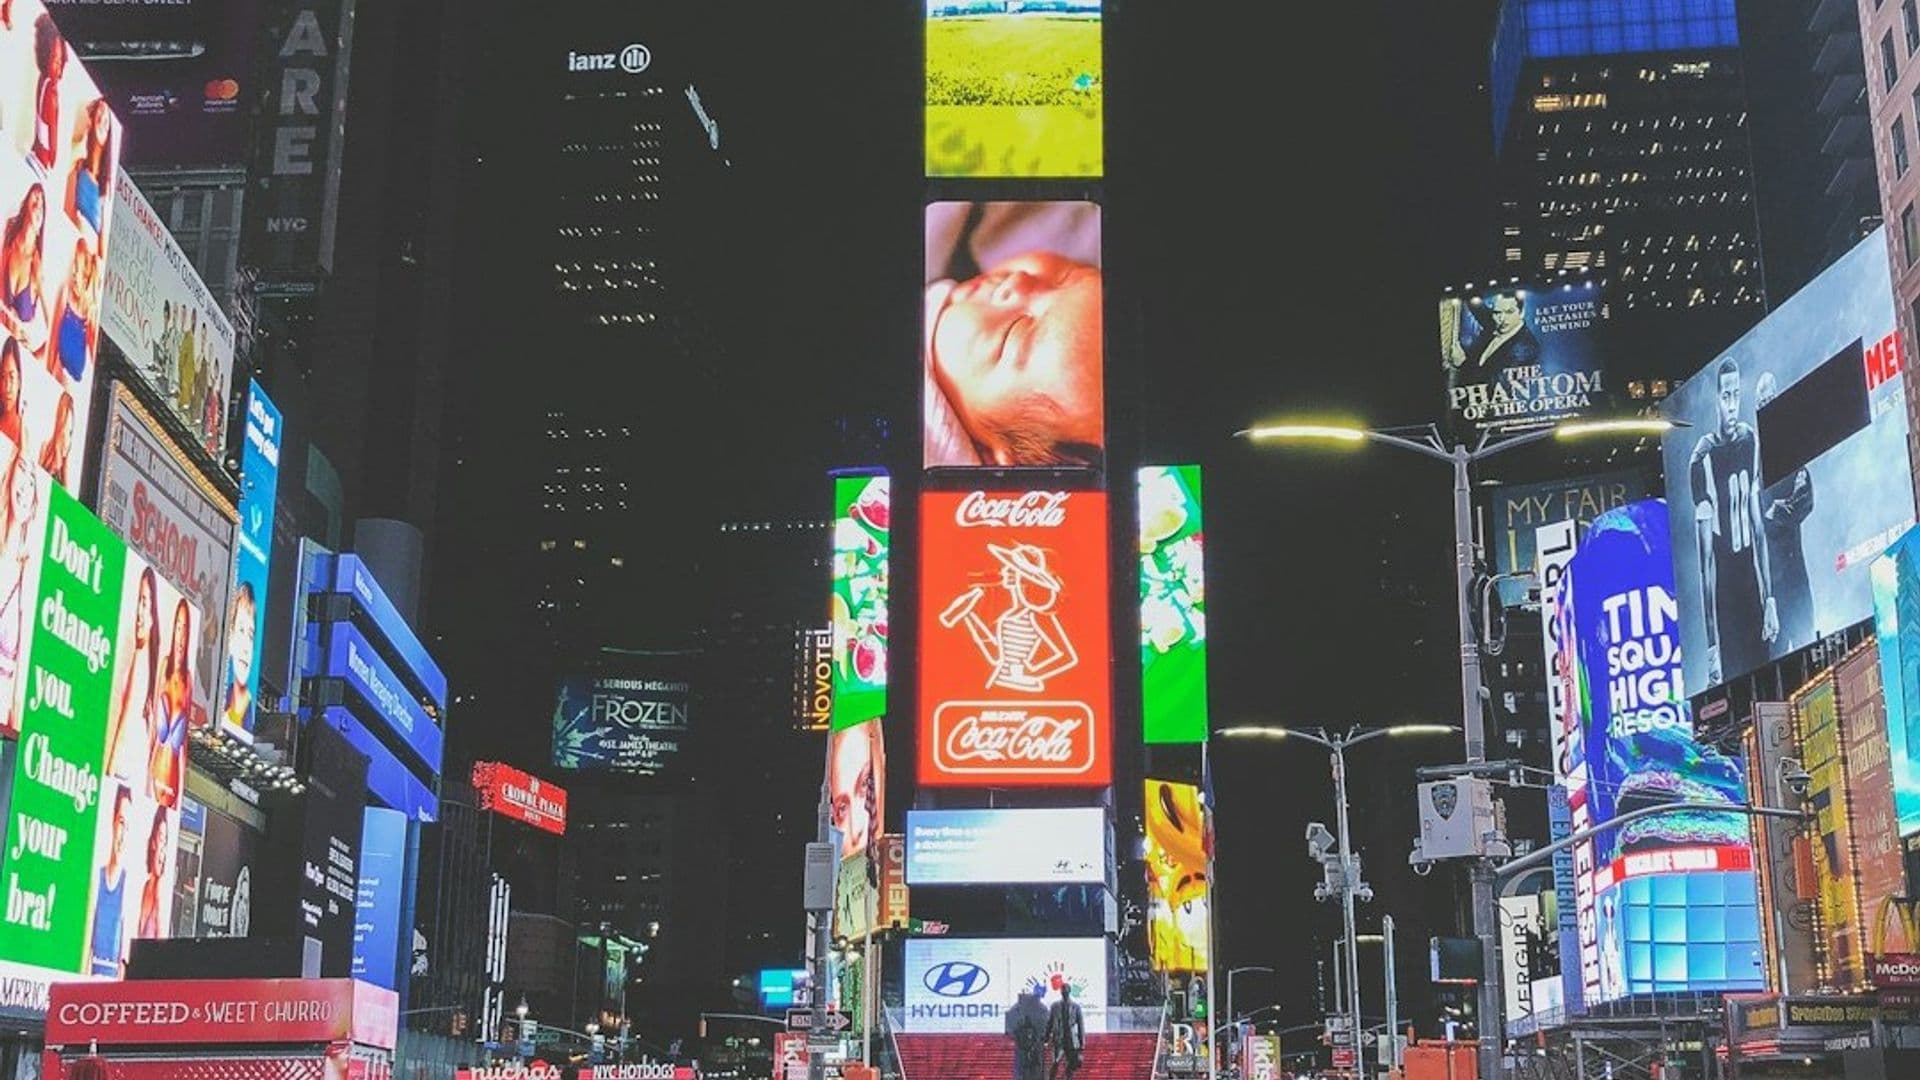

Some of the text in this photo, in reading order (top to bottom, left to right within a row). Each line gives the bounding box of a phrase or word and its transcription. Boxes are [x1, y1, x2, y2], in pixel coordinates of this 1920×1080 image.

[569, 52, 616, 71] ianz
[267, 217, 307, 232] NYC
[1541, 320, 1590, 333] UNWIND
[1449, 369, 1604, 410] PHANTOM
[1503, 364, 1543, 381] THE
[1463, 405, 1489, 421] OF
[1490, 400, 1528, 417] THE
[1529, 394, 1591, 412] OPERA
[955, 490, 1072, 527] Coca-Cola
[1507, 483, 1627, 527] MY FAIR
[49, 514, 105, 595] Don't
[130, 480, 200, 594] SCHOOL
[41, 588, 111, 674] change
[29, 664, 75, 719] you.
[811, 620, 832, 730] NOVOTEL
[592, 694, 688, 729] FROZEN
[946, 716, 1082, 761] Coca-Cola
[24, 732, 98, 813] Change
[11, 812, 67, 862] your
[5, 872, 56, 932] bra!
[60, 1002, 190, 1025] COFFEED
[204, 1001, 257, 1024] SWEET
[911, 1004, 999, 1018] HYUNDAI
[592, 1064, 617, 1080] NYC
